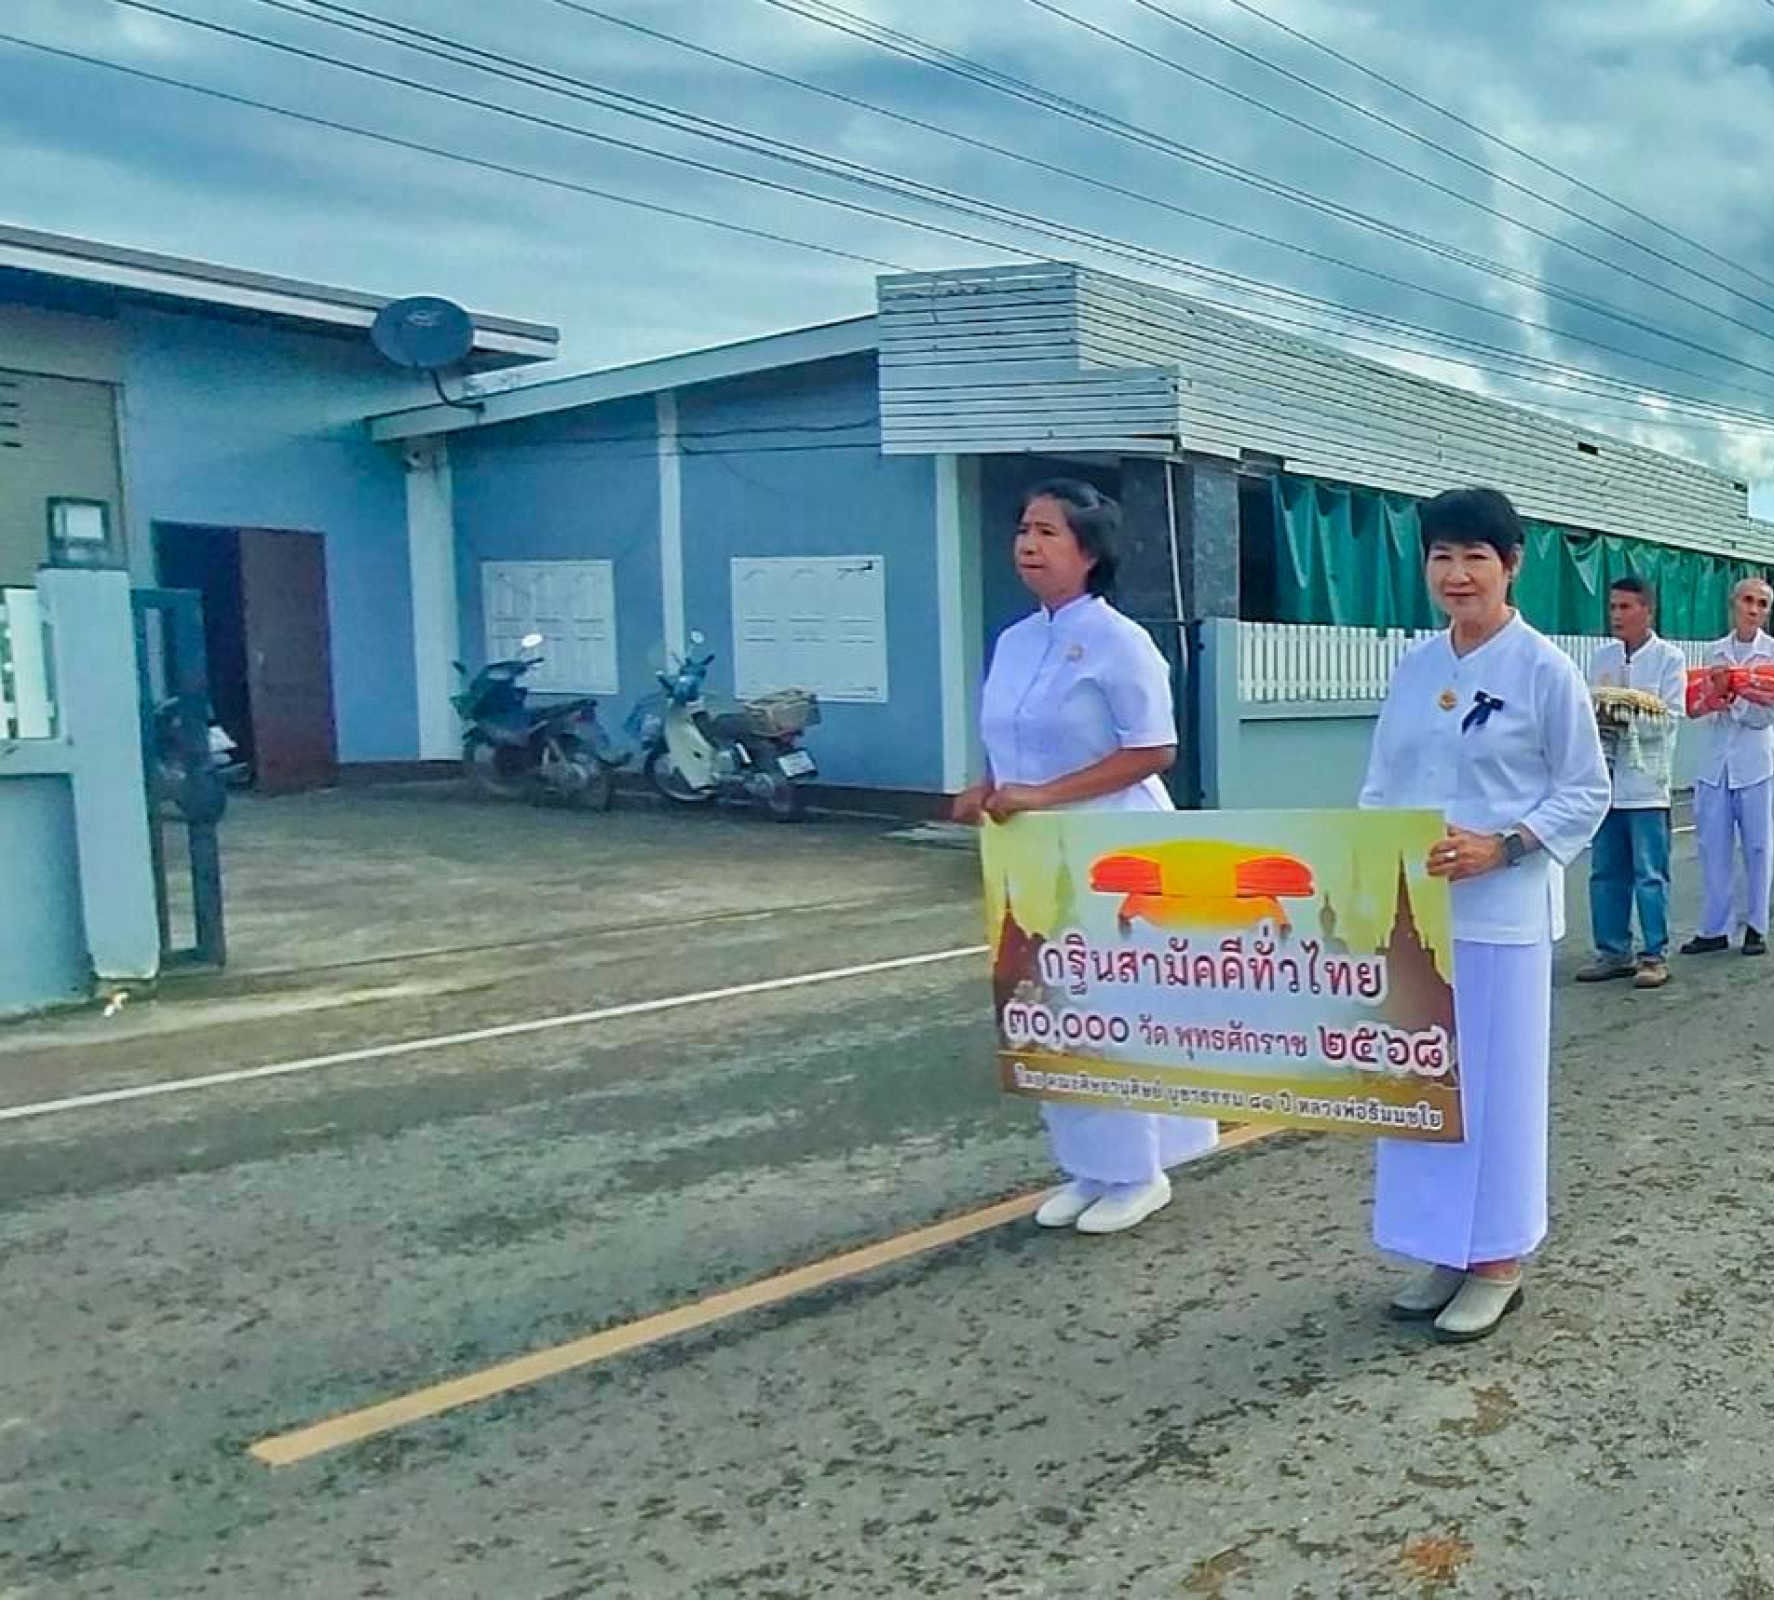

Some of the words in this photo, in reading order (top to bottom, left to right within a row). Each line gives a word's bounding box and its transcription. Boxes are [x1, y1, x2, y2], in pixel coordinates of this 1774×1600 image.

[1043, 924, 1382, 996] กฐินสามัคคีทั่วไทย
[1138, 1012, 1169, 1046] วัด
[1174, 1019, 1307, 1060] พุทธศักราช
[1316, 1024, 1446, 1069] ๒๕๖๘
